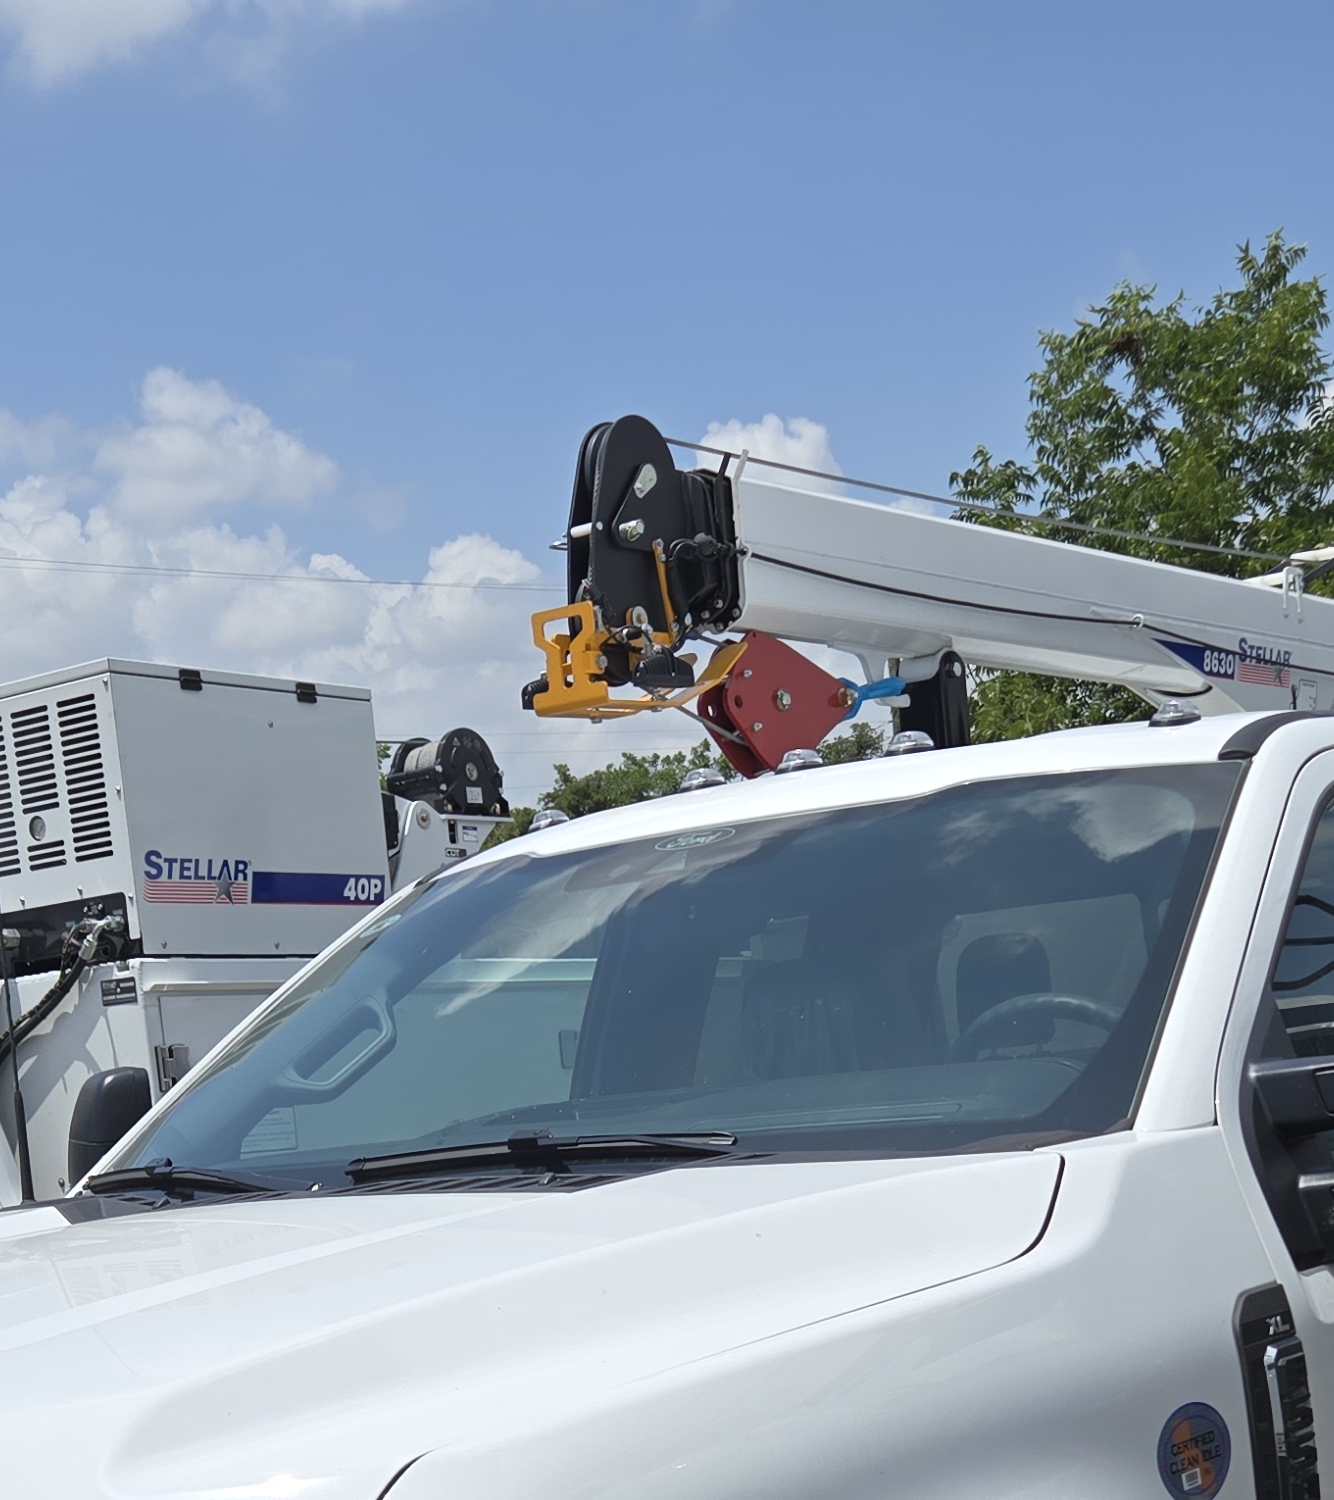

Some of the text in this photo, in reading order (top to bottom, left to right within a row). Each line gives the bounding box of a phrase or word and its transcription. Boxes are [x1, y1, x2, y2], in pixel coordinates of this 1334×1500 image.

[1203, 650, 1235, 675] 8630
[1238, 637, 1291, 666] STELLAR
[665, 831, 723, 849] Ford
[143, 850, 248, 881] STELLAR
[343, 877, 382, 901] 40P
[1265, 1315, 1291, 1335] XL
[1170, 1430, 1216, 1457] CERTIFIED
[1169, 1453, 1200, 1475] CLEAN
